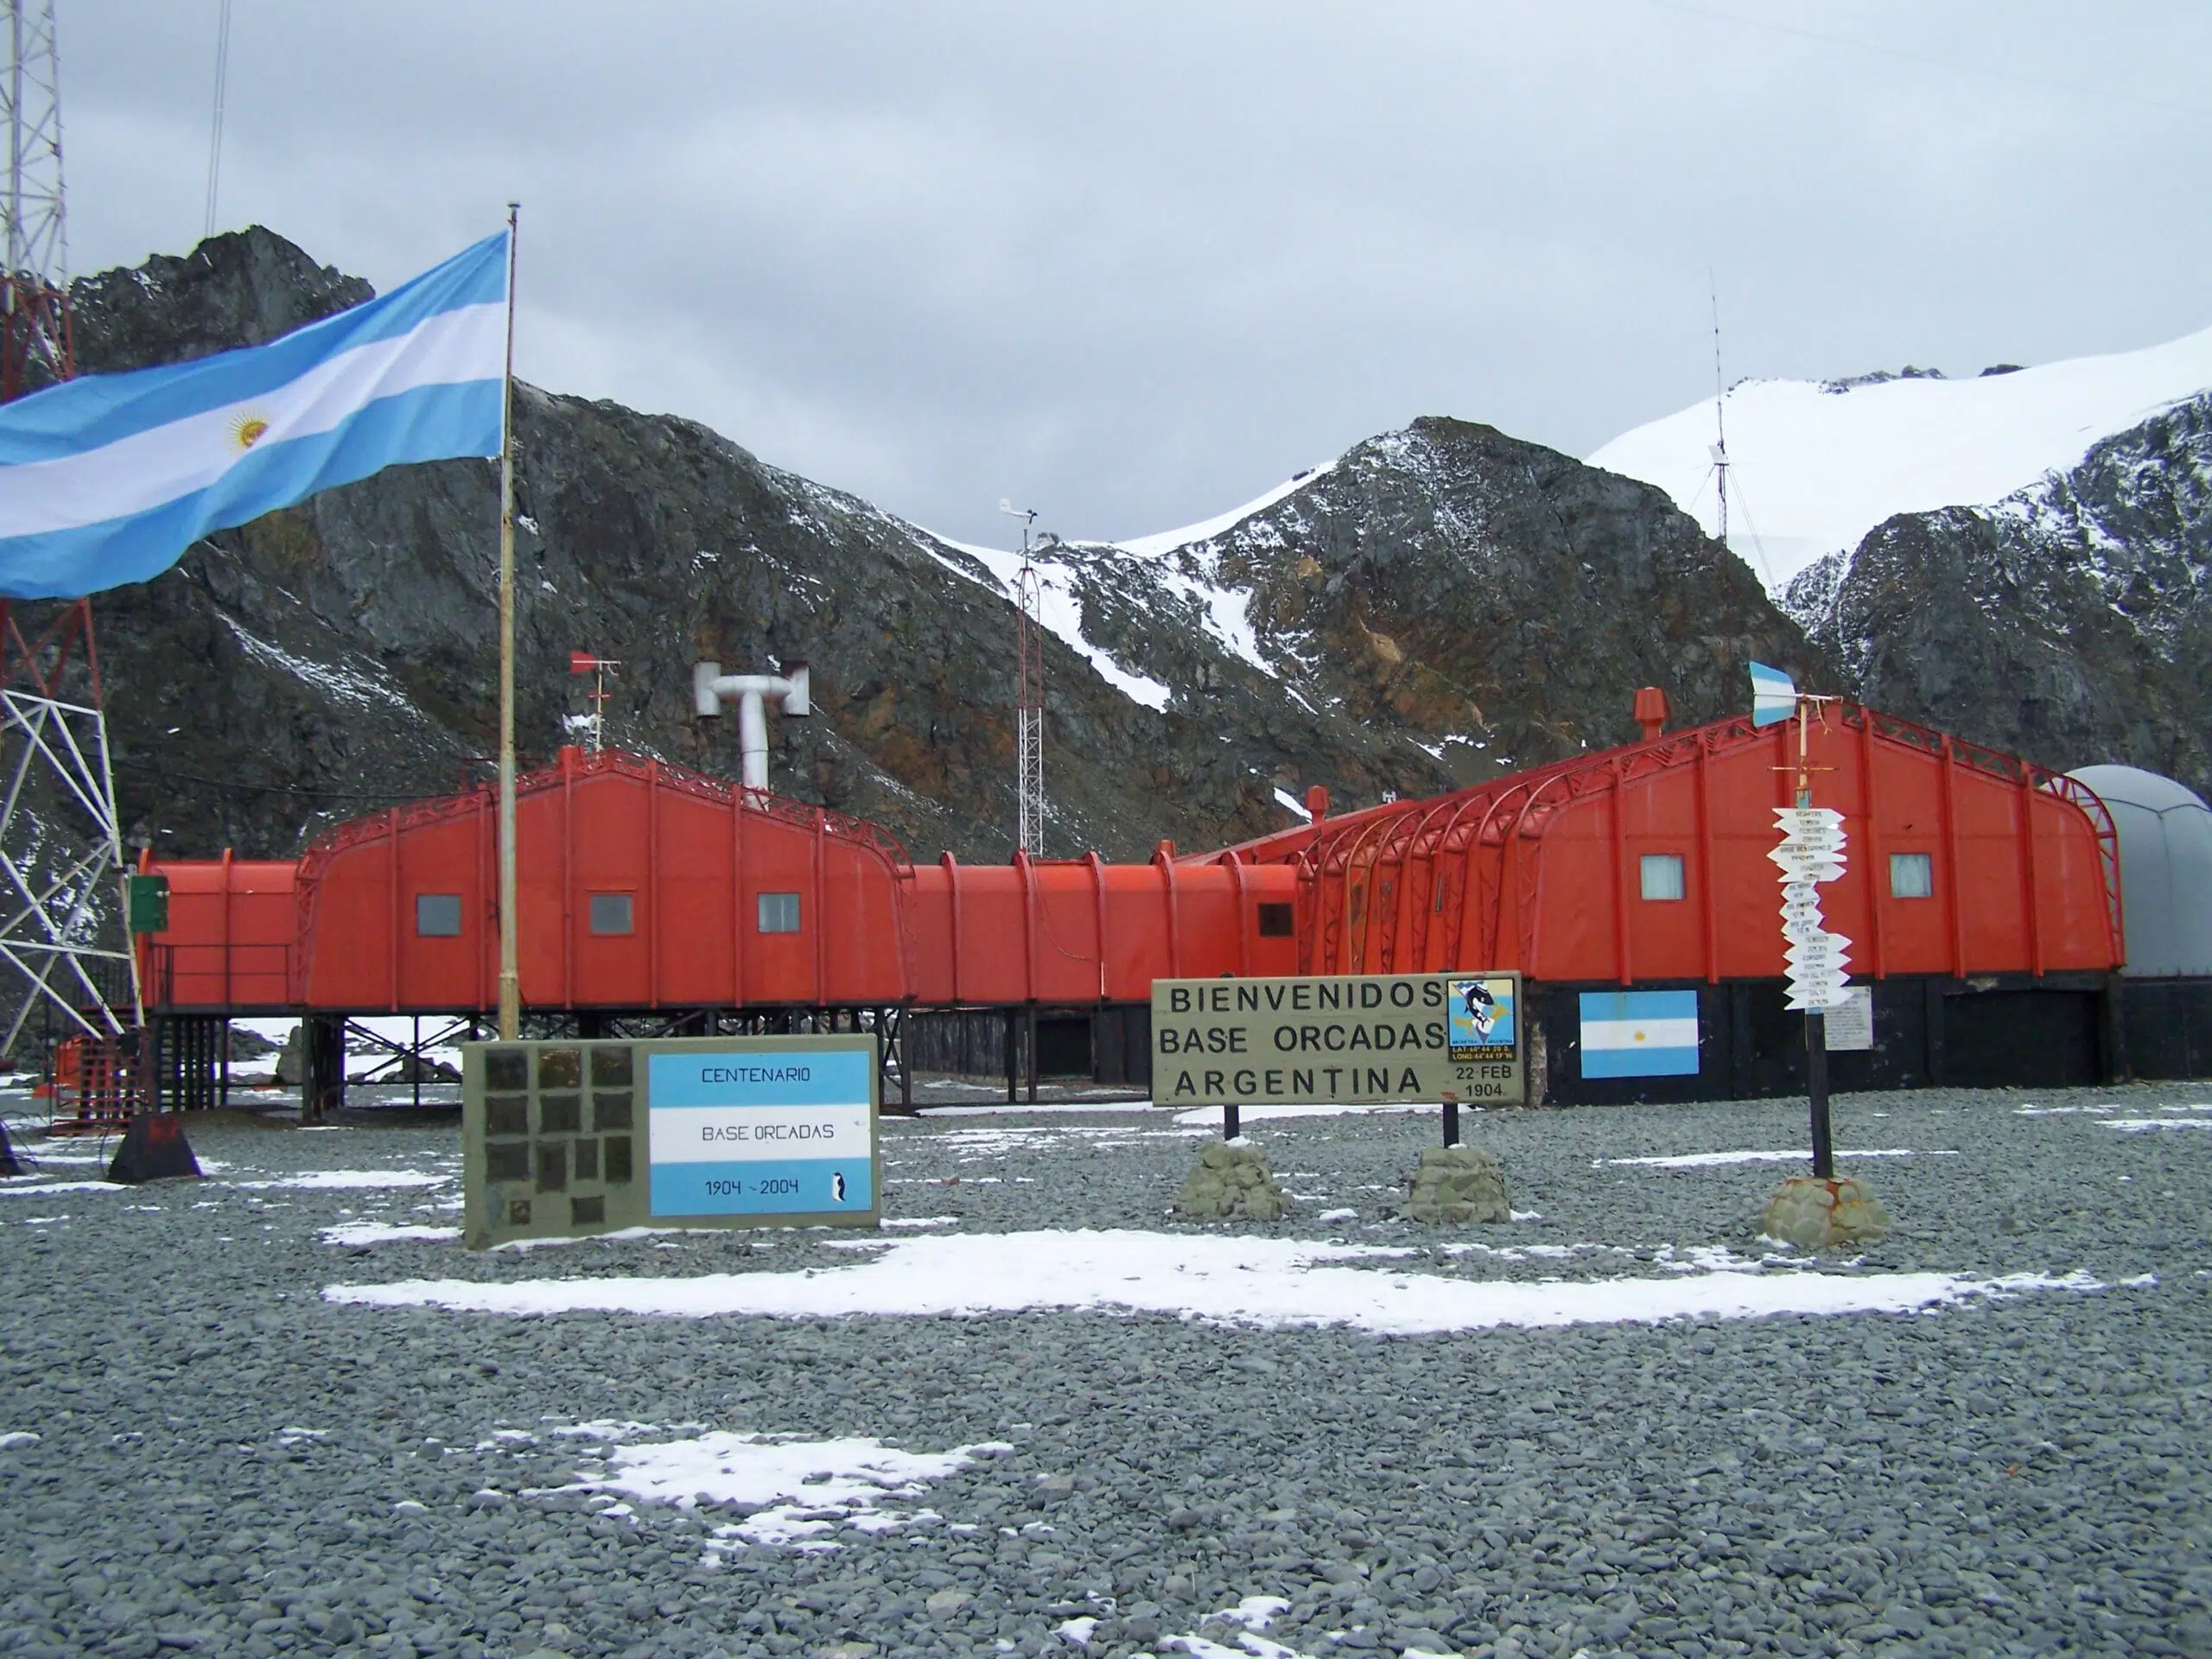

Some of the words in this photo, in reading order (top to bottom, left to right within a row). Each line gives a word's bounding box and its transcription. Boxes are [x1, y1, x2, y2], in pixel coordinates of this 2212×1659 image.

[1170, 982, 1443, 1013] BIENVENIDOS
[1160, 1027, 1248, 1054] BASE
[1274, 1022, 1445, 1052] ORCADAS
[702, 1067, 810, 1083] CENTENARIO
[1456, 1066, 1474, 1079] 22
[1481, 1065, 1511, 1078] FEB
[1173, 1067, 1421, 1096] ARGENTINA
[1465, 1084, 1503, 1096] 1904
[702, 1126, 749, 1141] BASE
[754, 1124, 834, 1140] ORCADAS
[705, 1180, 741, 1195] 1904
[760, 1179, 799, 1195] 2004
